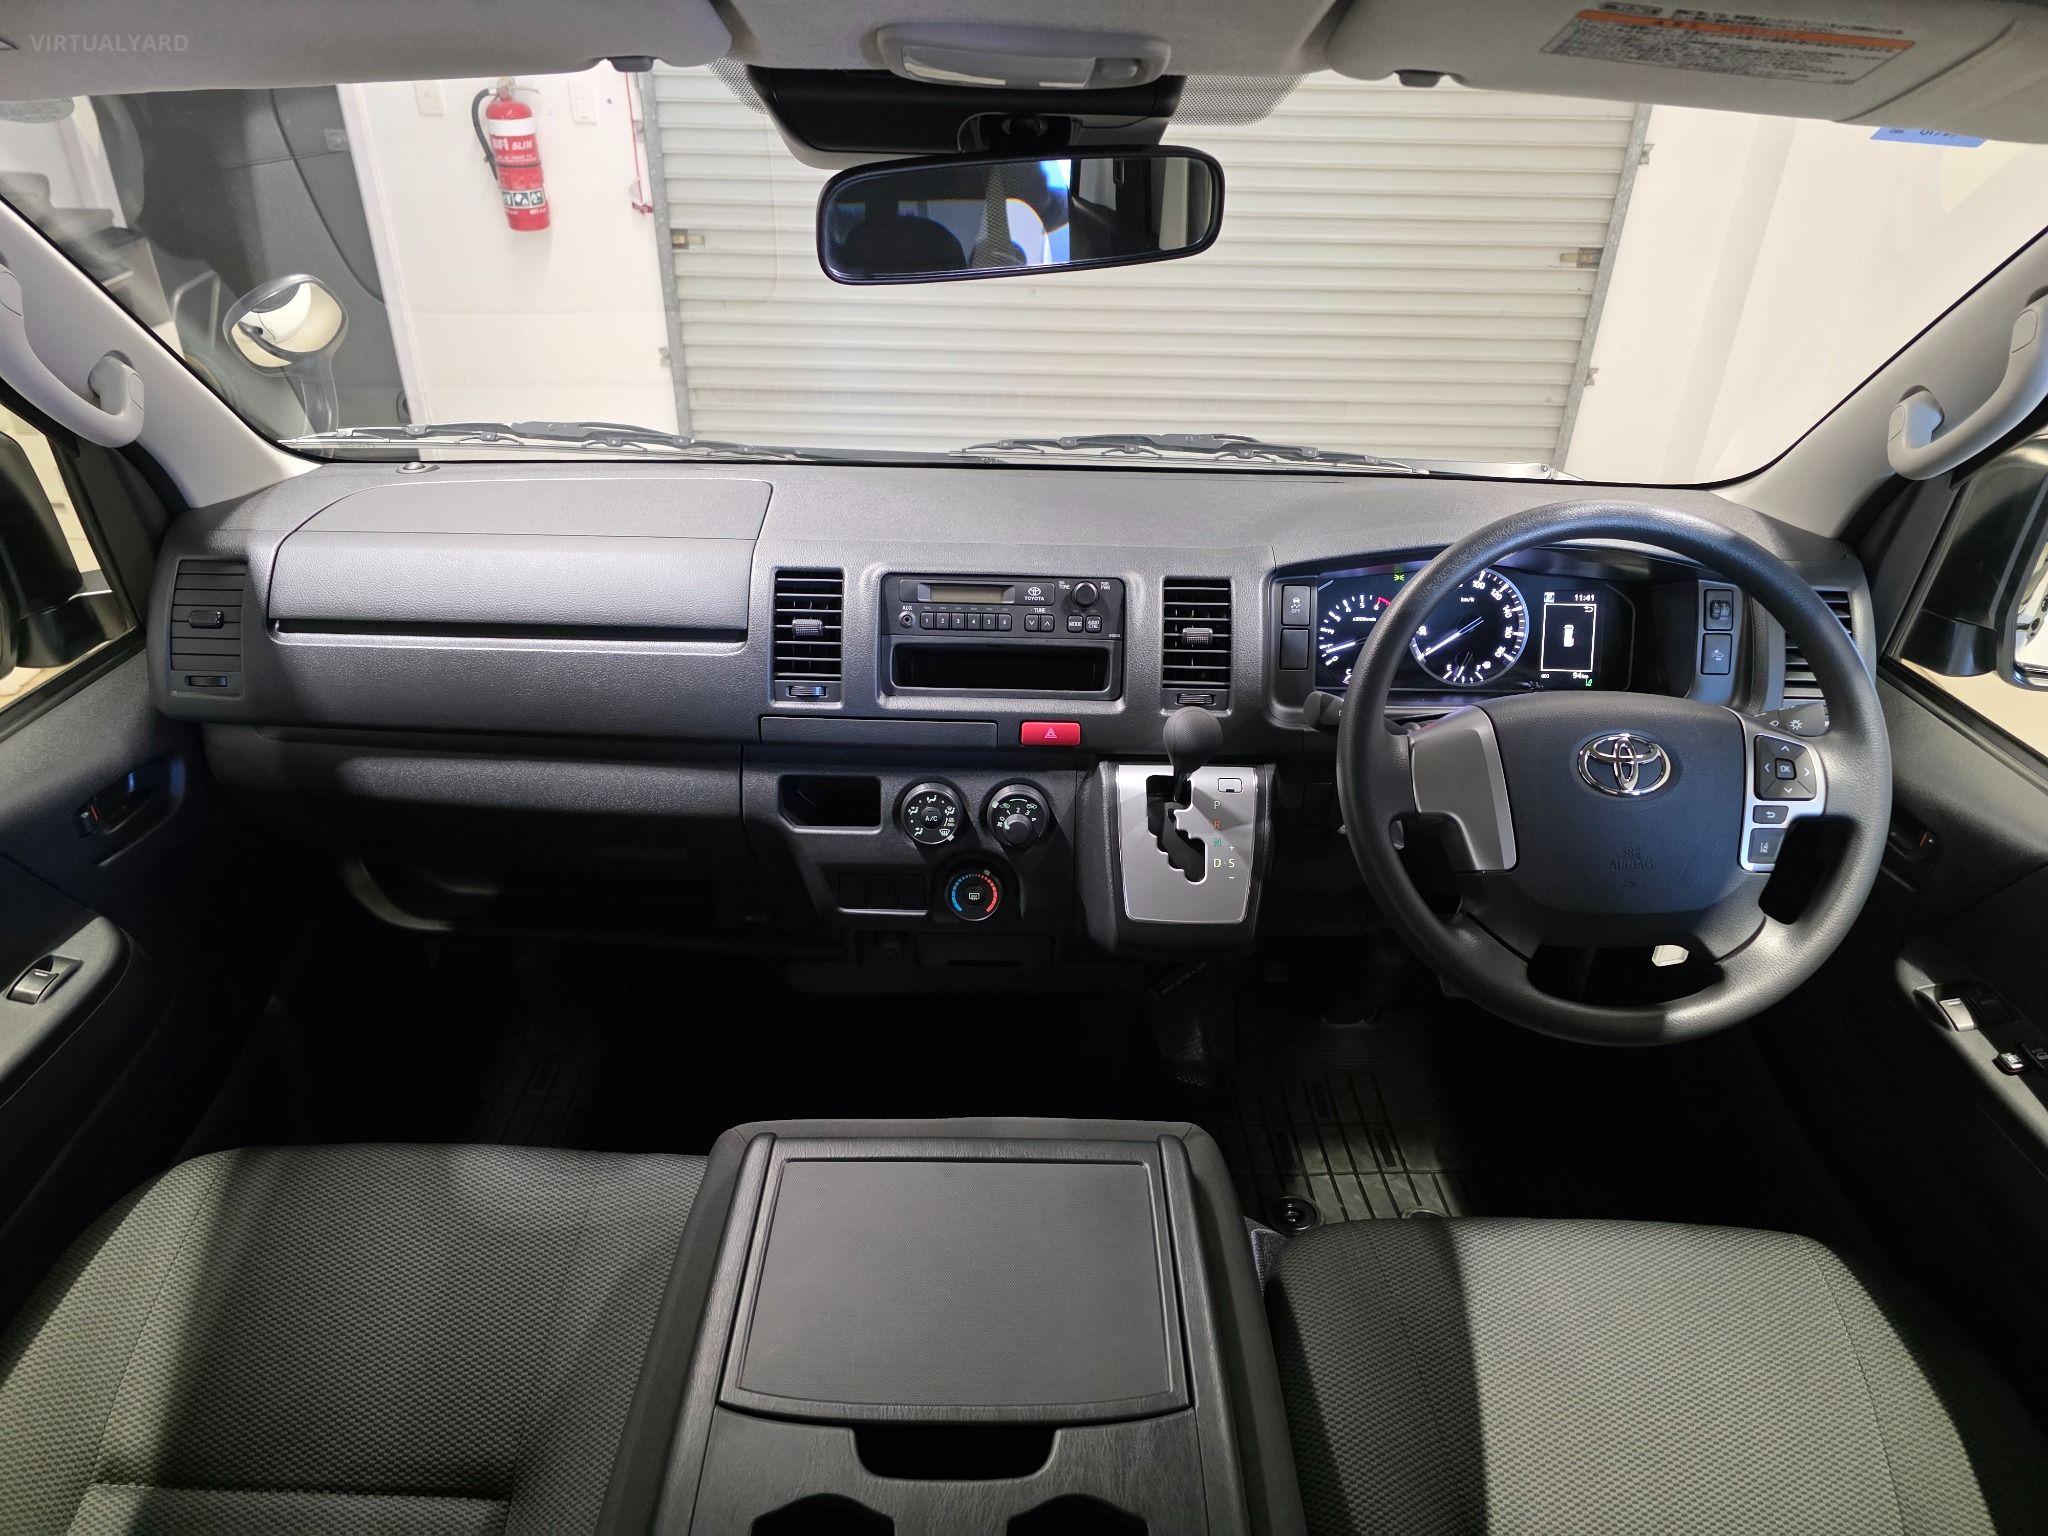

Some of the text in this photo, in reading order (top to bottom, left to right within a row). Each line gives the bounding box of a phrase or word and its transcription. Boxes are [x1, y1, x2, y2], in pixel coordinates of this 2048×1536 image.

[1472, 580, 1486, 590] 100
[1490, 588, 1503, 601] 120
[1574, 593, 1595, 602] 11:41
[1374, 601, 1380, 611] 6
[1502, 605, 1512, 618] 140
[1504, 626, 1513, 639] 160
[1495, 646, 1506, 658] 180
[1476, 664, 1481, 672] F
[1780, 765, 1791, 773] OK
[1213, 801, 1221, 810] P
[1214, 821, 1221, 830] R
[1214, 837, 1222, 847] N
[1213, 859, 1235, 868] D S
[1608, 859, 1654, 872] AIRBAG
